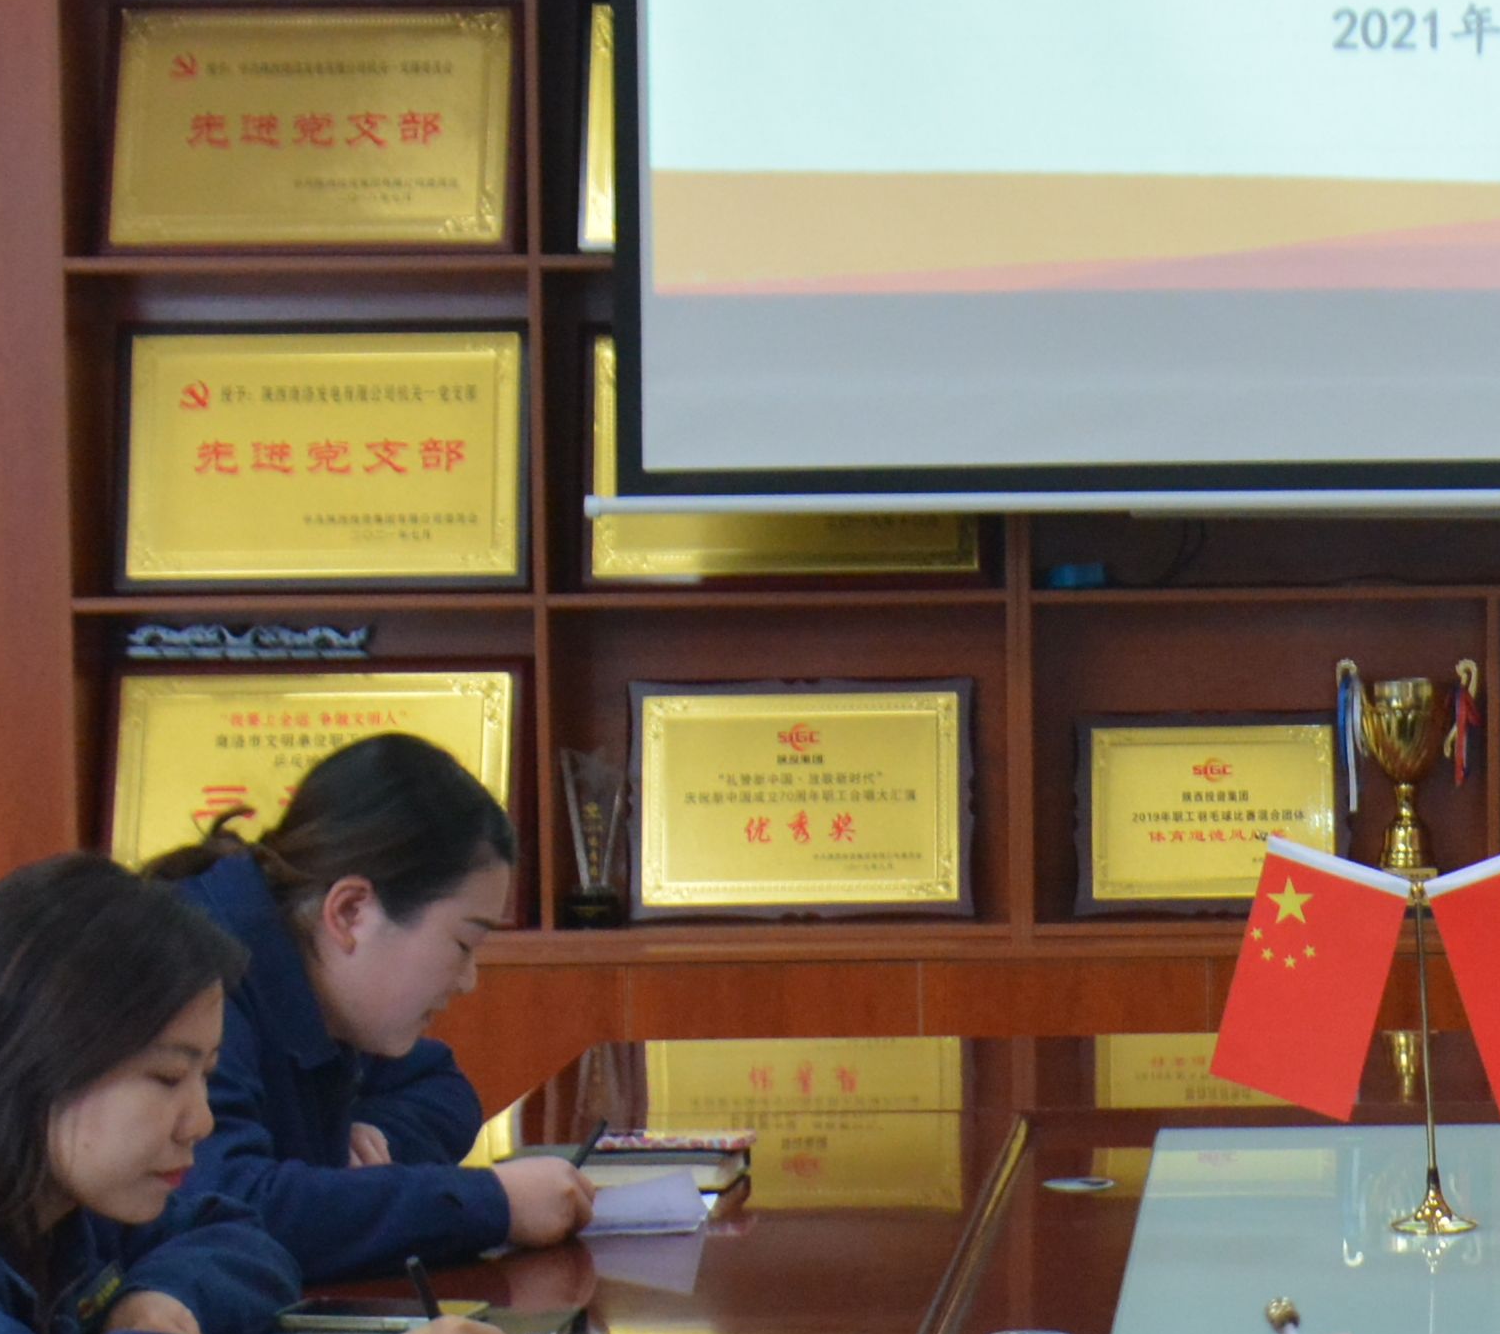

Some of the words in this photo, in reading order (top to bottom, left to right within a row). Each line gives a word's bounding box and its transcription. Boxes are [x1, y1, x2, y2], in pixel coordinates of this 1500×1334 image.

[186, 109, 444, 150] 先进党支部
[193, 438, 468, 476] 先进党支部
[1181, 790, 1250, 803] 陕西投资集团
[744, 809, 857, 845] 优秀奖
